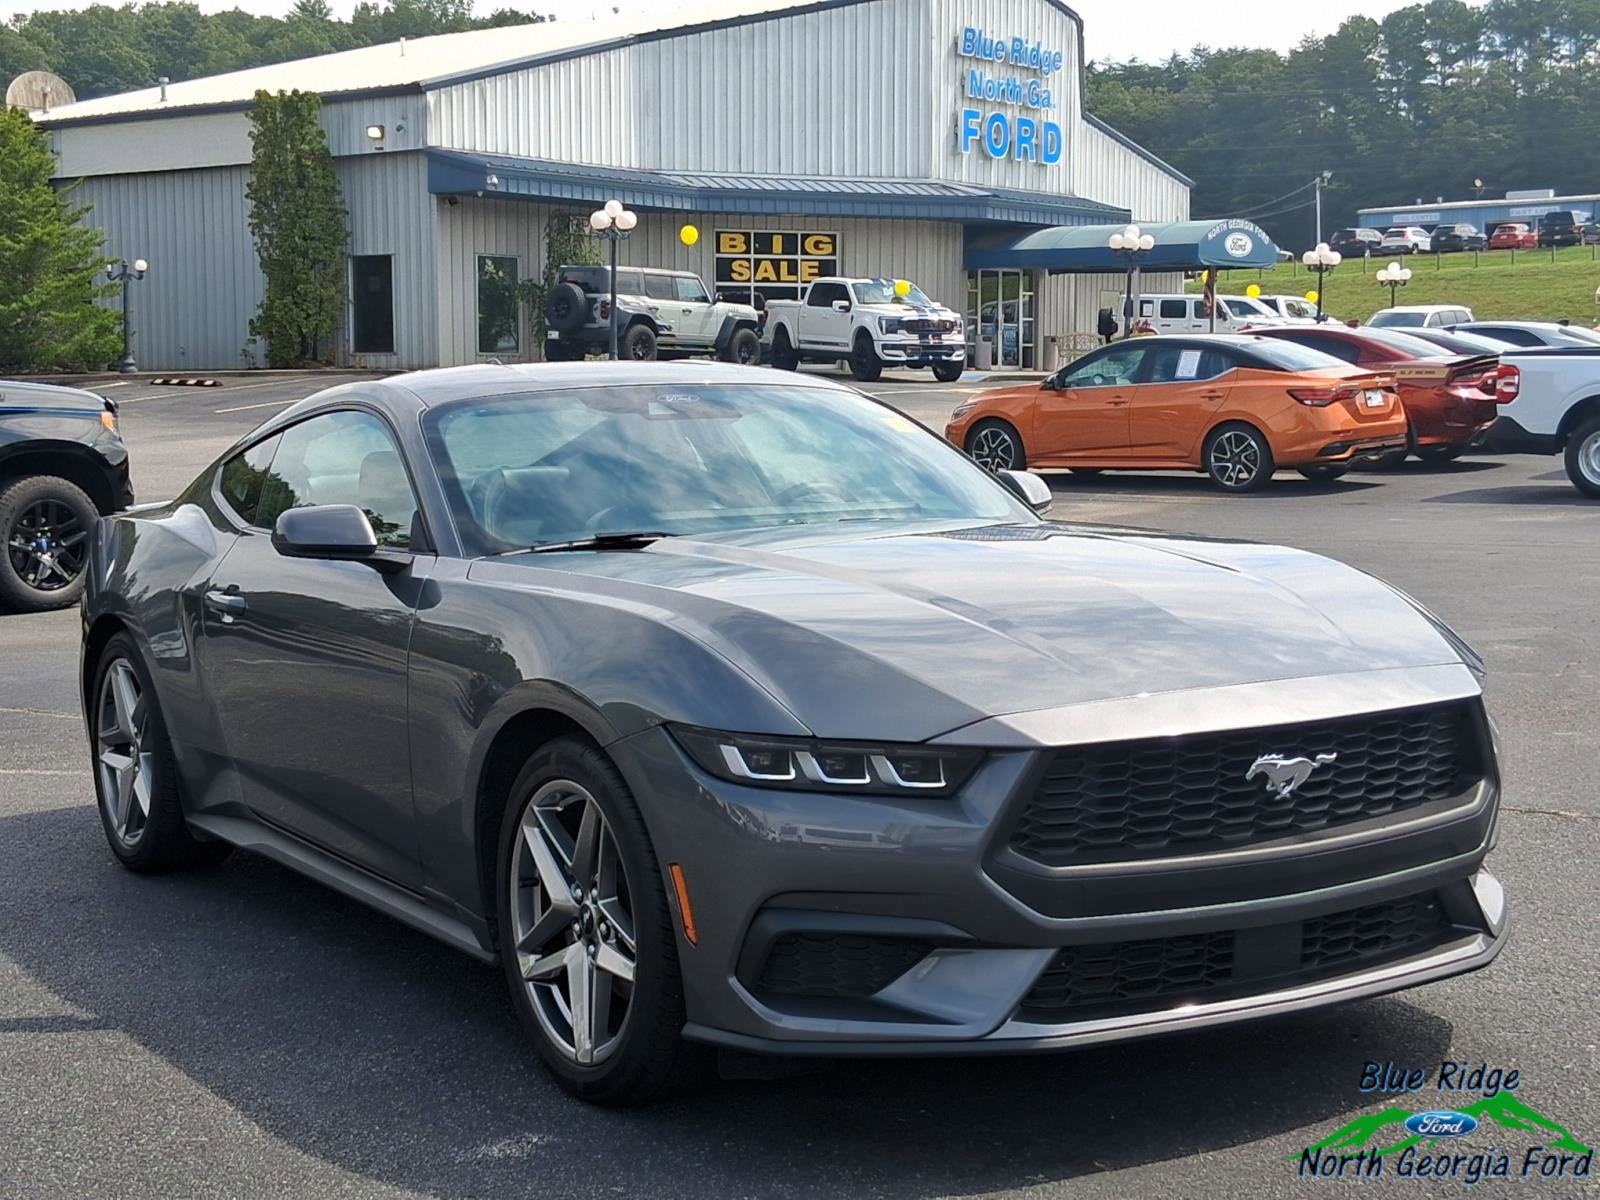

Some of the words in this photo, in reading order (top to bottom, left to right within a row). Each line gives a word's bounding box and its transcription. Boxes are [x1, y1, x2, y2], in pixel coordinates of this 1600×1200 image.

[961, 27, 1005, 62] Blue
[1009, 36, 1063, 76] Ridge
[967, 68, 1024, 105] North
[1027, 78, 1056, 109] Ga.
[961, 107, 1063, 165] FORD
[719, 232, 833, 255] BIG
[1207, 220, 1228, 241] NORTH
[1228, 219, 1254, 232] GEORGIA
[1254, 225, 1270, 245] FORD
[1229, 237, 1247, 252] Ford
[731, 260, 820, 281] SALE
